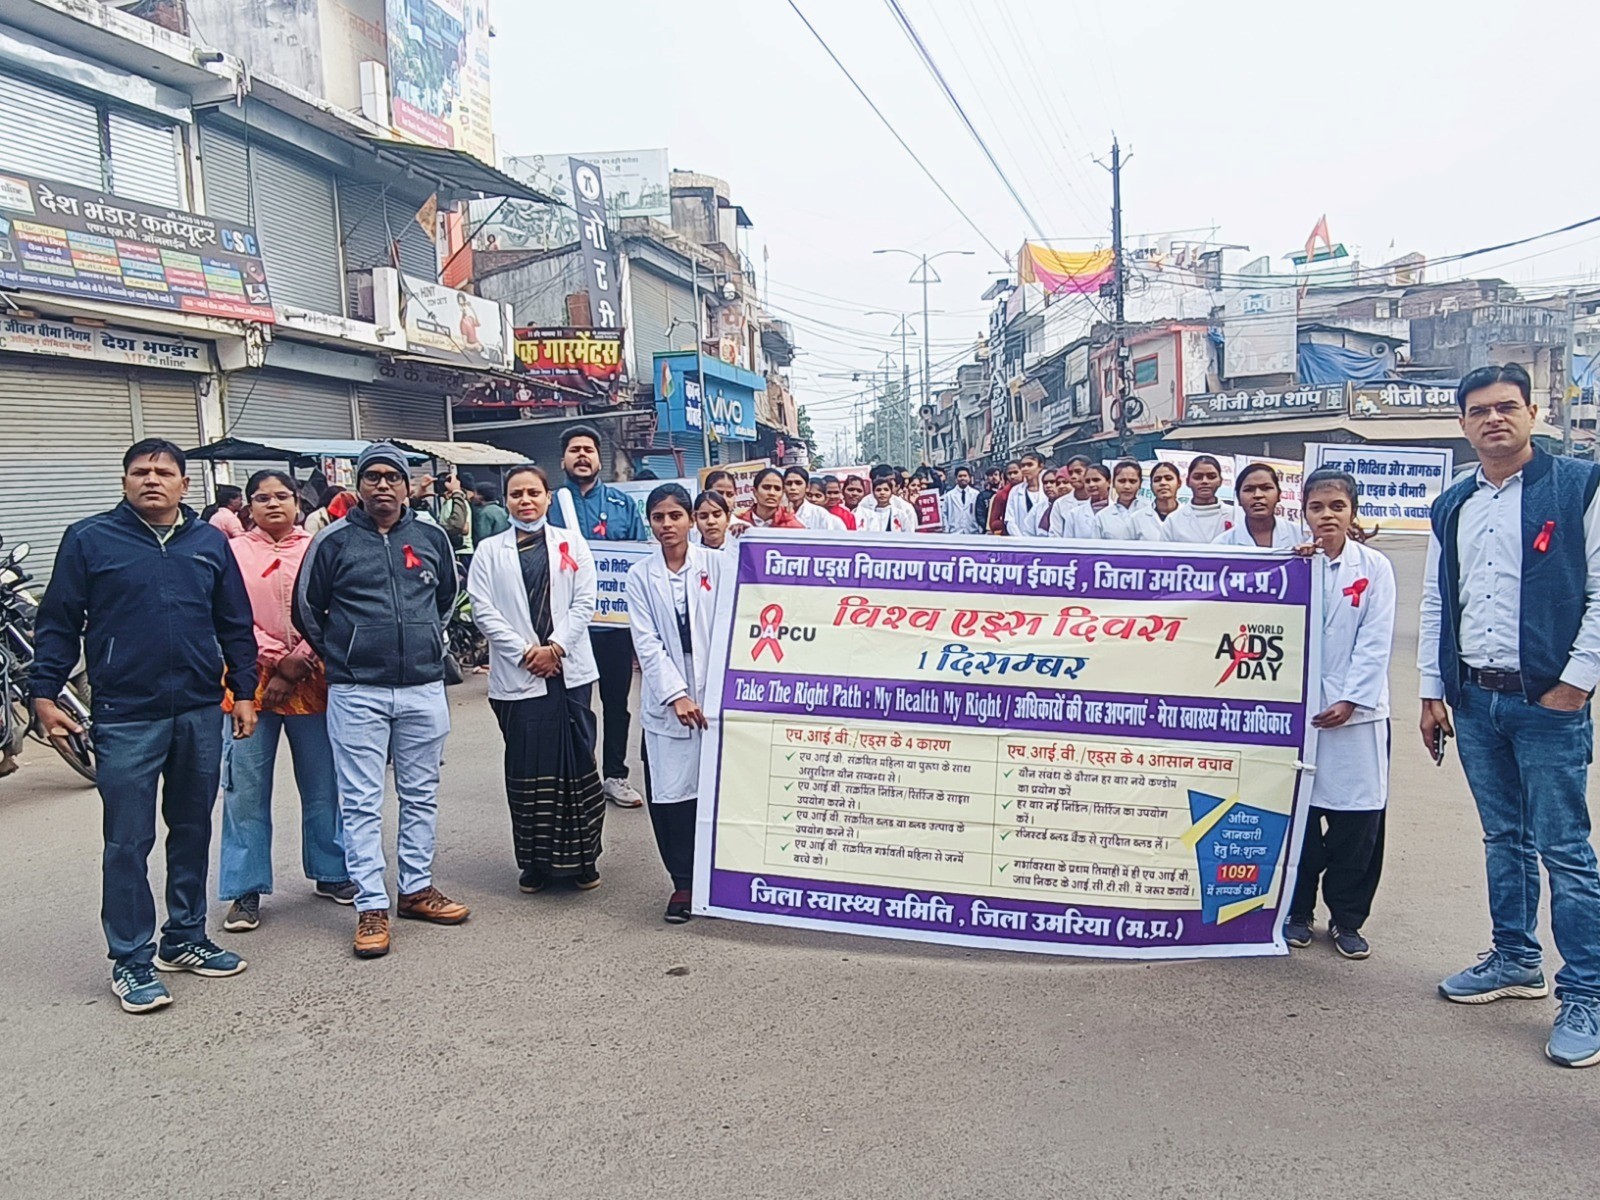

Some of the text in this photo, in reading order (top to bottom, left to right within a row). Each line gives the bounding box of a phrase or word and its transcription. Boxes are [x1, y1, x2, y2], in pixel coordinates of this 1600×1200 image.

[36, 184, 217, 248] देश भंडार कम्प्यूटर
[221, 229, 256, 255] CSC
[4, 318, 91, 342] जीवन बीमा निगम
[100, 332, 200, 359] देश भण्डार
[1209, 386, 1321, 411] श्रीजी बैग शॉप
[1379, 384, 1422, 406] श्रीजी
[708, 389, 742, 423] vivo
[1343, 458, 1355, 474] को
[1357, 459, 1387, 475] शिक्षित
[1388, 460, 1405, 476] और
[1366, 484, 1386, 500] एड्स
[1388, 482, 1397, 497] के
[1398, 483, 1426, 498] बीमारी
[1360, 502, 1387, 517] परिवार
[1389, 503, 1401, 517] को
[600, 558, 610, 572] को
[765, 550, 810, 577] जिला
[813, 557, 850, 584] एड्स
[854, 553, 923, 582] निवाराण
[928, 559, 956, 583] एवं
[1027, 558, 1078, 591] ईकाई
[1094, 561, 1145, 591] जिला
[1149, 564, 1215, 593] उमरिया
[1218, 565, 1288, 600] (म.प्र.)
[833, 596, 947, 632] विश्व
[1053, 605, 1188, 643] दिवस
[749, 624, 817, 642] DAPCU
[1247, 624, 1284, 634] WORLD
[917, 643, 1090, 680] 1 दिसम्बर
[1237, 661, 1283, 681] DAY
[735, 678, 764, 702] Take
[768, 680, 790, 704] The
[793, 682, 828, 712] Right
[832, 684, 862, 709] Path
[874, 686, 893, 717] My
[895, 687, 939, 714] Health
[943, 690, 962, 721] My
[965, 692, 1002, 724] Right
[1014, 692, 1065, 721] अधिकारों
[1066, 697, 1082, 721] की
[1084, 701, 1103, 723] राह
[1104, 699, 1149, 726] अपनाएं
[1157, 699, 1178, 728] मेरा
[1221, 702, 1242, 732] मेरा
[1242, 705, 1292, 735] अधिकार
[890, 731, 902, 748] के
[905, 738, 913, 748] 4
[916, 738, 951, 752] कारण
[880, 756, 904, 769] महिला
[906, 760, 916, 769] या
[941, 760, 950, 771] के
[952, 764, 971, 773] साथ
[1120, 747, 1134, 764] के
[1136, 754, 1144, 765] 4
[1148, 754, 1194, 769] आसान
[1198, 757, 1233, 772] बचाव
[837, 767, 853, 779] यौन
[887, 771, 895, 782] से
[1018, 766, 1036, 778] यौन
[1063, 769, 1072, 781] के
[1074, 770, 1099, 783] दौरान
[1101, 775, 1111, 785] हर
[1114, 776, 1128, 785] बार
[1131, 775, 1145, 786] नये
[1148, 776, 1177, 788] कण्डोम
[1018, 783, 1071, 796] का प्रयोग करें
[1016, 799, 1168, 819] हर बार नई का उपयोग
[1016, 812, 1029, 824] करें
[1228, 811, 1260, 825] अधिक
[1088, 832, 1097, 844] से
[1222, 828, 1262, 841] जानकारी
[812, 854, 823, 865] को
[874, 845, 905, 858] गर्भवती
[908, 847, 932, 861] महिला
[934, 849, 942, 861] से
[1214, 842, 1228, 859] हेतु
[1033, 874, 1058, 887] निकट
[1060, 876, 1069, 888] के
[1221, 865, 1256, 879] 1097
[1207, 884, 1258, 896] में सम्पर्क करें
[750, 877, 1184, 941] जिला स्वास्थ्य समिति जिला उमरिया (म.प्र.)
